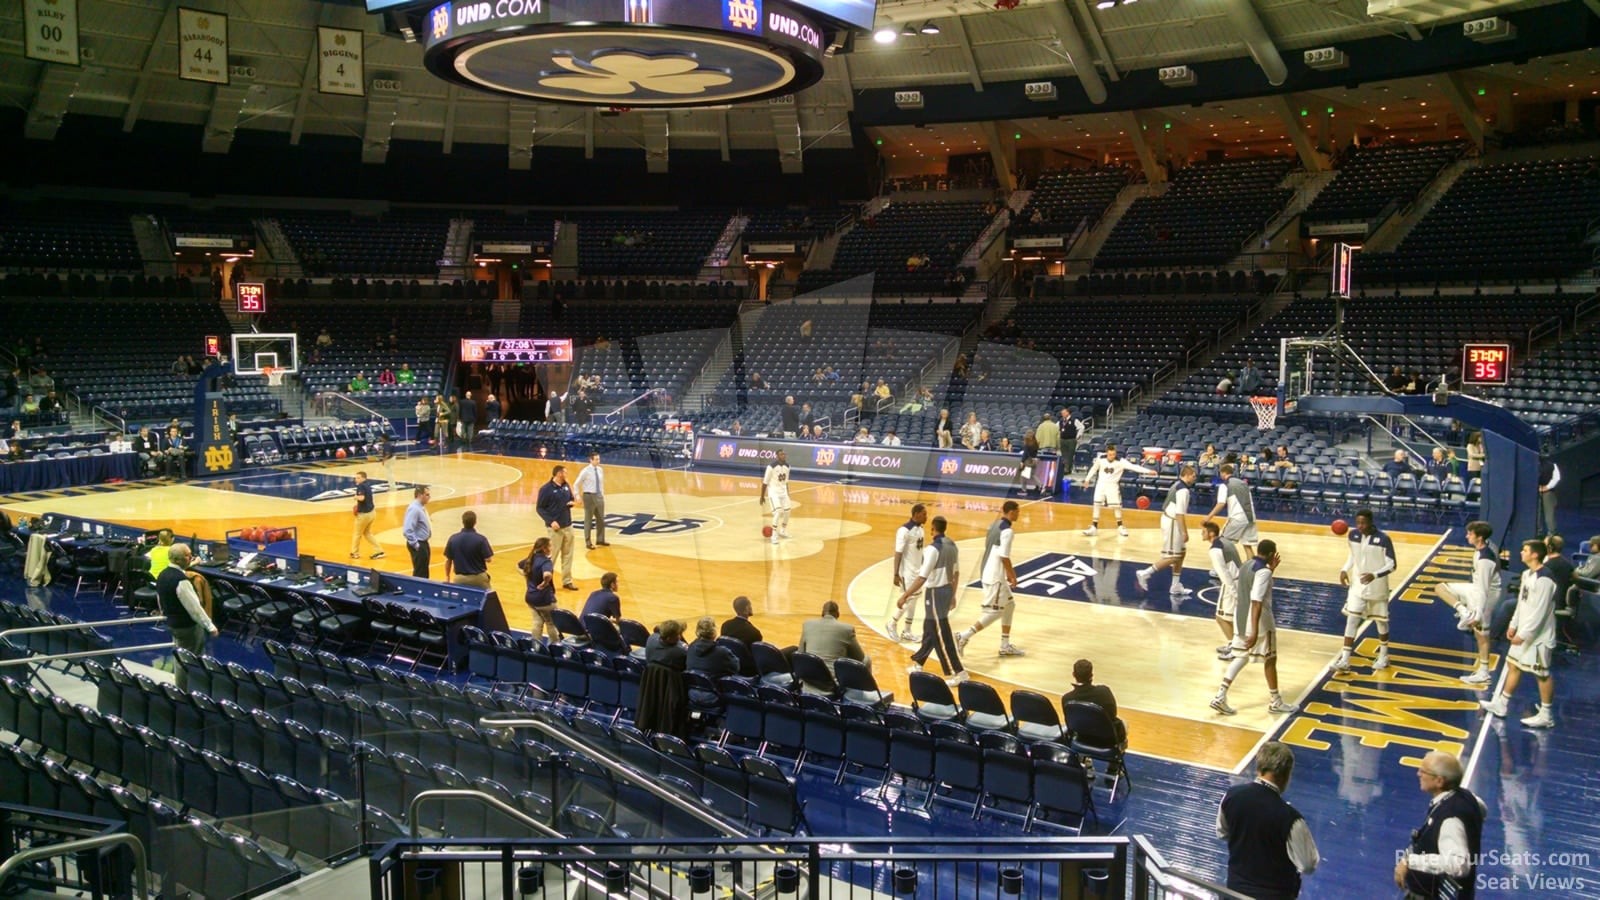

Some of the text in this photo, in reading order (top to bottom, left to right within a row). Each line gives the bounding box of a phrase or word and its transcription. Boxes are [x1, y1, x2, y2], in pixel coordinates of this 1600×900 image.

[456, 0, 541, 26] UND.COM
[41, 24, 62, 42] 00
[769, 12, 819, 48] UND.COM
[193, 47, 213, 63] 44
[336, 63, 345, 77] 4
[240, 286, 261, 295] 37:04
[243, 295, 259, 309] 35
[1470, 350, 1503, 362] 37:04
[1475, 362, 1496, 378] 35
[211, 400, 221, 440] IRISH
[842, 454, 901, 468] UND.COM
[964, 463, 1017, 477] UND.COM
[1016, 558, 1098, 596] ACC
